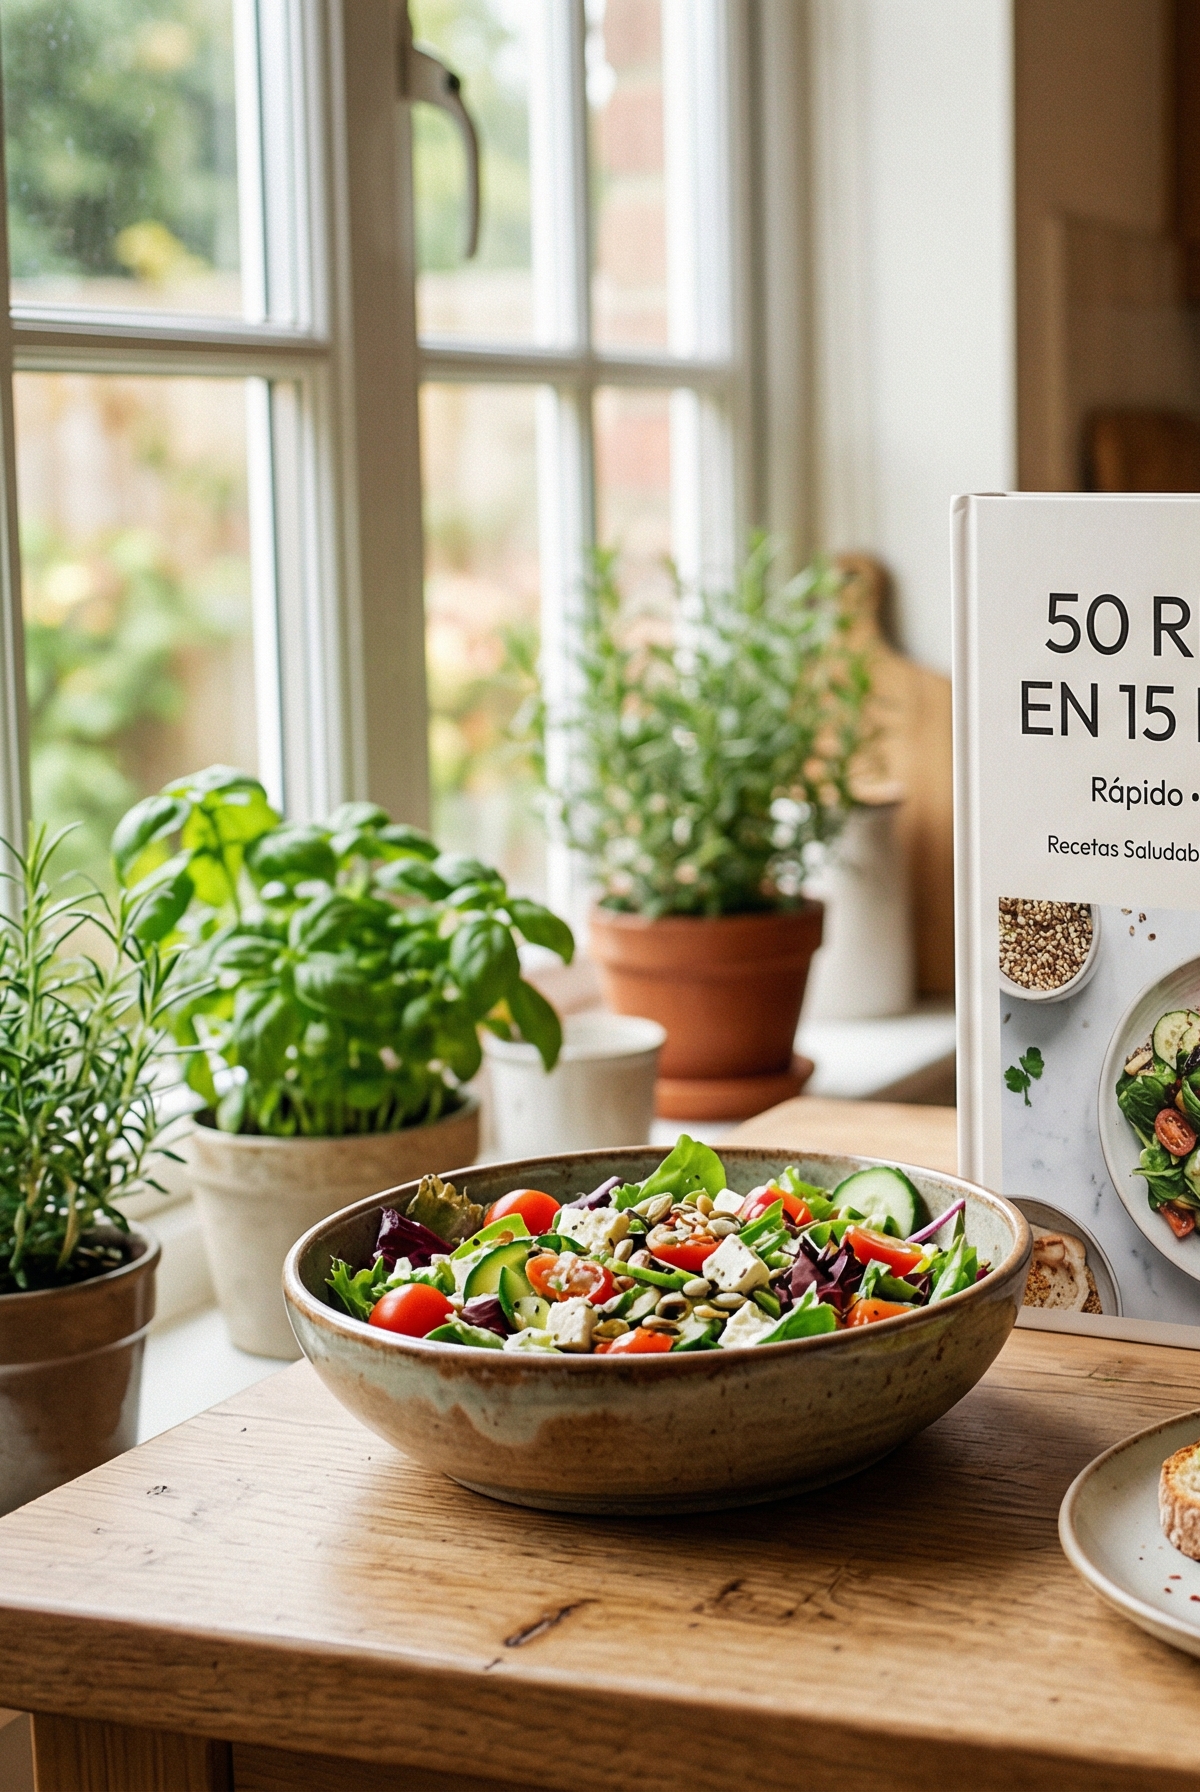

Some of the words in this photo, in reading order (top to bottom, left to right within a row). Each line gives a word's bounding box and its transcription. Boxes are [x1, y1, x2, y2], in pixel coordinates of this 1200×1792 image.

[1044, 592, 1130, 656] 50
[1020, 680, 1099, 738] EN
[1118, 684, 1177, 742] 15
[1091, 776, 1184, 811] Rápido
[1047, 834, 1119, 858] Recetas
